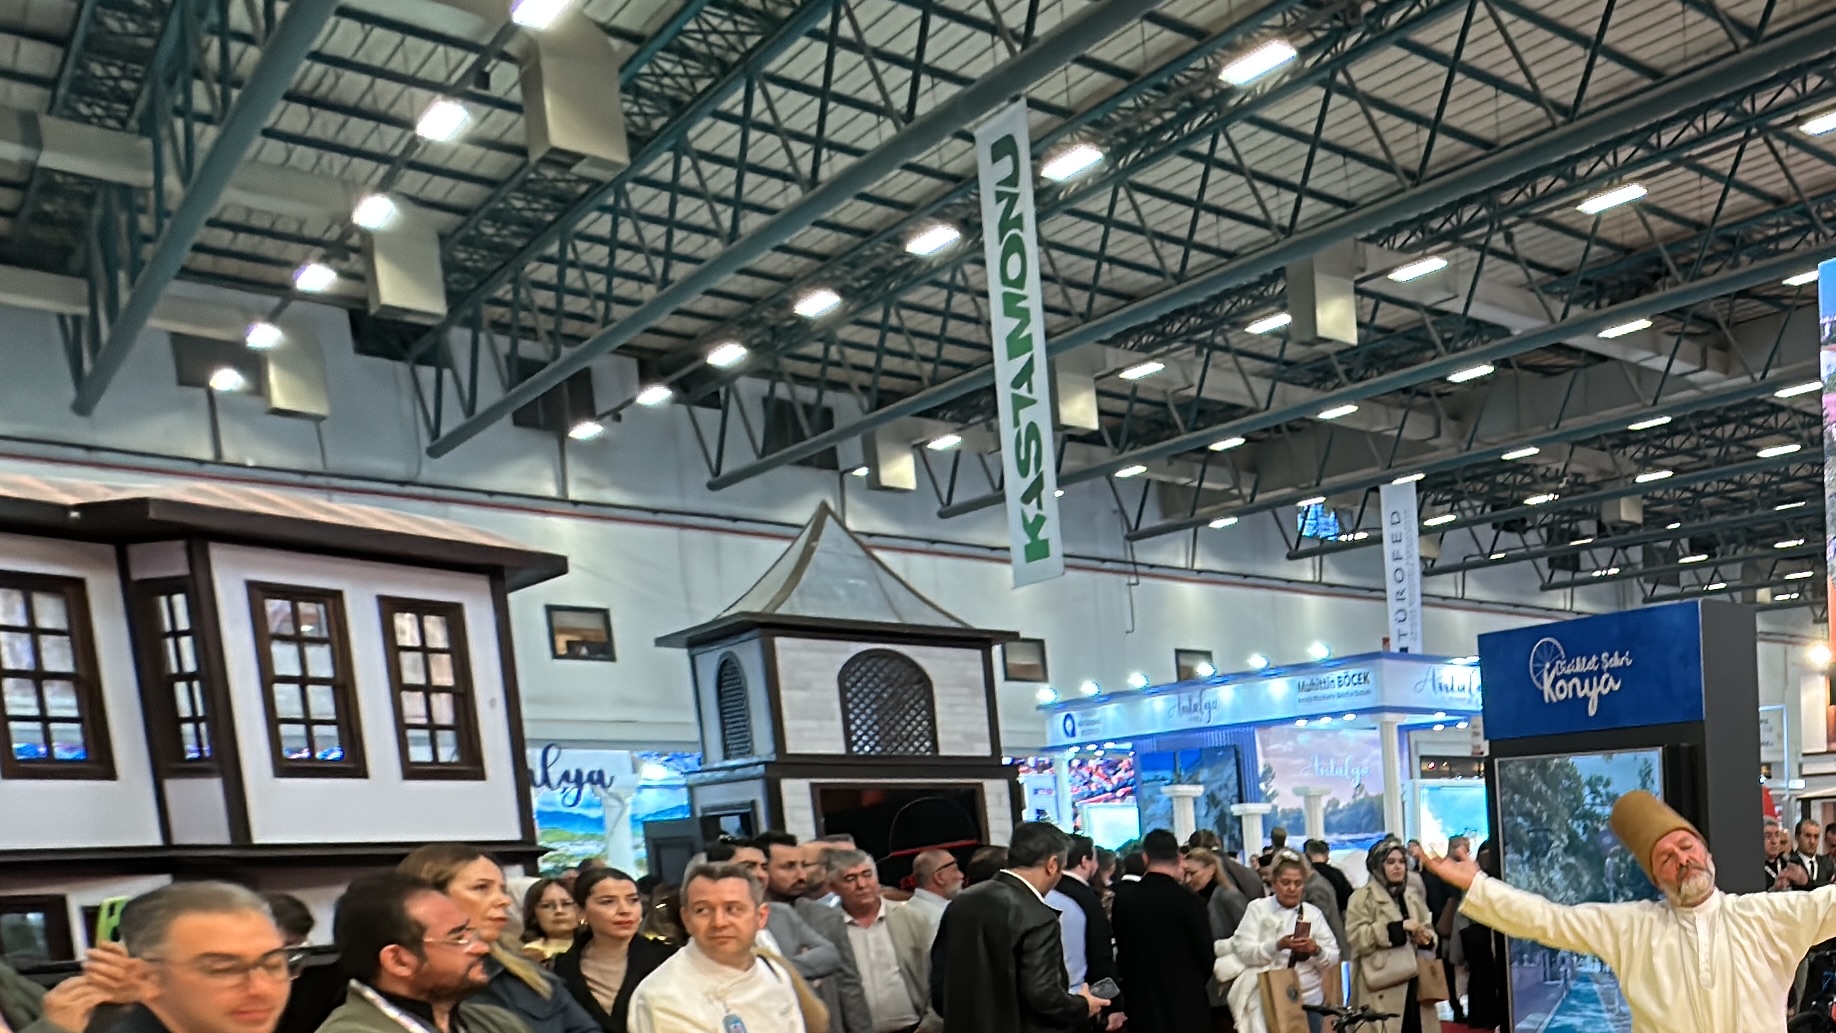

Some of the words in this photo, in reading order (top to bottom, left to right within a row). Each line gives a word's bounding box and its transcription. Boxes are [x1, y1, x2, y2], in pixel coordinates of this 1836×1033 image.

[990, 133, 1051, 564] KASTAMONU
[1389, 510, 1409, 643] TÜROFED
[1337, 671, 1370, 688] BÖCEK
[1543, 662, 1622, 717] Konya
